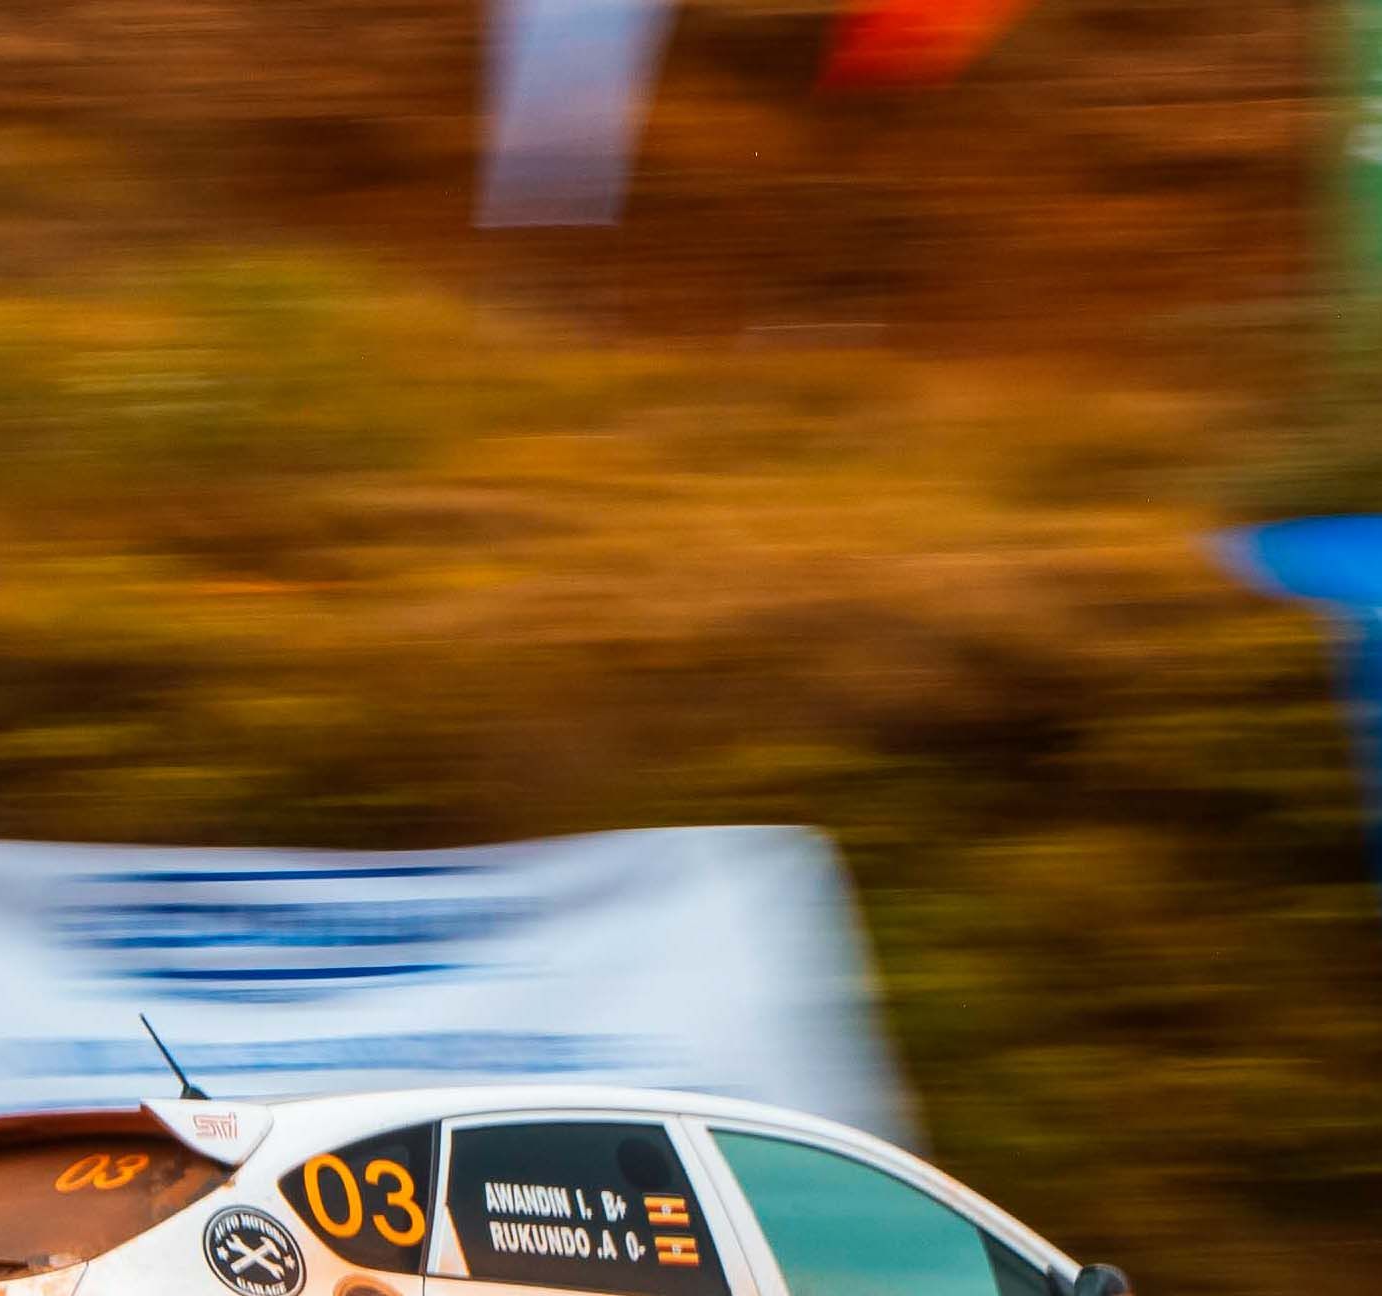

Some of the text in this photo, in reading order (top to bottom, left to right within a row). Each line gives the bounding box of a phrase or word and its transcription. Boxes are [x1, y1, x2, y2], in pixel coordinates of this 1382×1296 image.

[55, 1153, 150, 1194] 03
[304, 1152, 426, 1247] 03
[484, 1181, 571, 1219] AWANDIN
[488, 1220, 591, 1259] RUKUNDO
[236, 1276, 287, 1296] GARAGE
